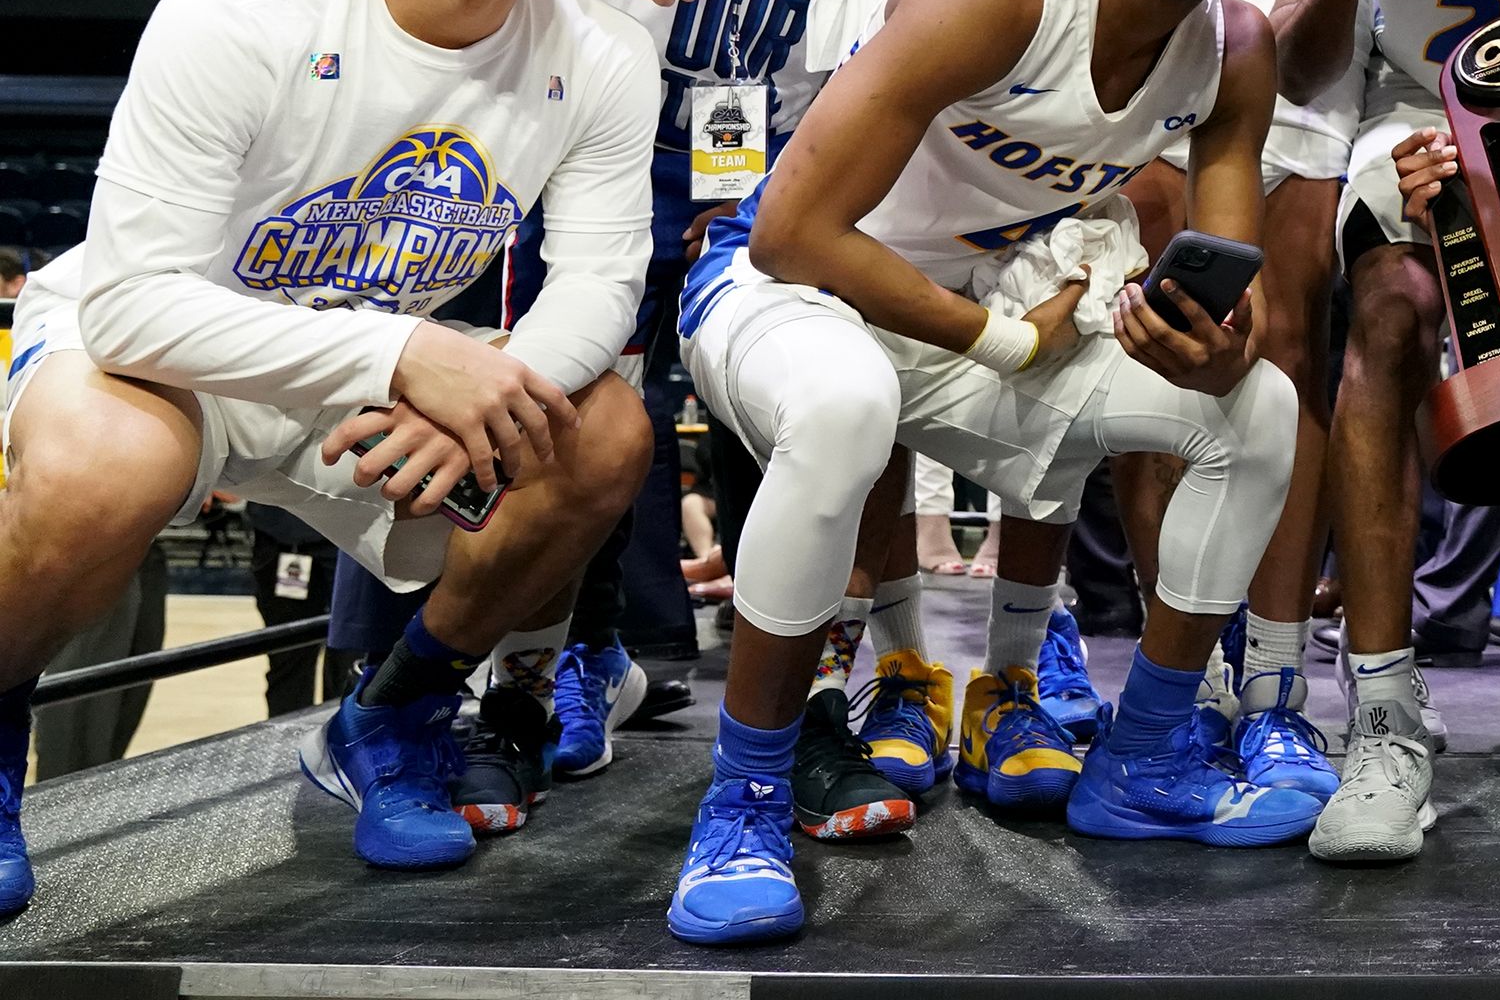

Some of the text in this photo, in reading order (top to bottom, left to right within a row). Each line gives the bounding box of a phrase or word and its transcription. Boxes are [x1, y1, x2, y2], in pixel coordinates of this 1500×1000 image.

[713, 109, 743, 120] CAA
[1164, 112, 1197, 131] CA
[711, 155, 746, 167] TEAM
[949, 120, 1150, 196] HOFST
[384, 162, 462, 194] CAA
[306, 193, 510, 227] MEN'S BASKETBALL
[1443, 226, 1473, 241] COLLEGE OF
[1444, 232, 1476, 247] CHARLESTON
[234, 217, 515, 292] CHAMPION
[1451, 256, 1480, 270] UNIVERSITY
[1457, 261, 1485, 275] DELAWARE
[1460, 292, 1489, 306] UNIVERSITY
[1463, 288, 1483, 299] DREXEL
[1466, 323, 1496, 338] UNIVERSITY
[1472, 319, 1487, 330] ELON
